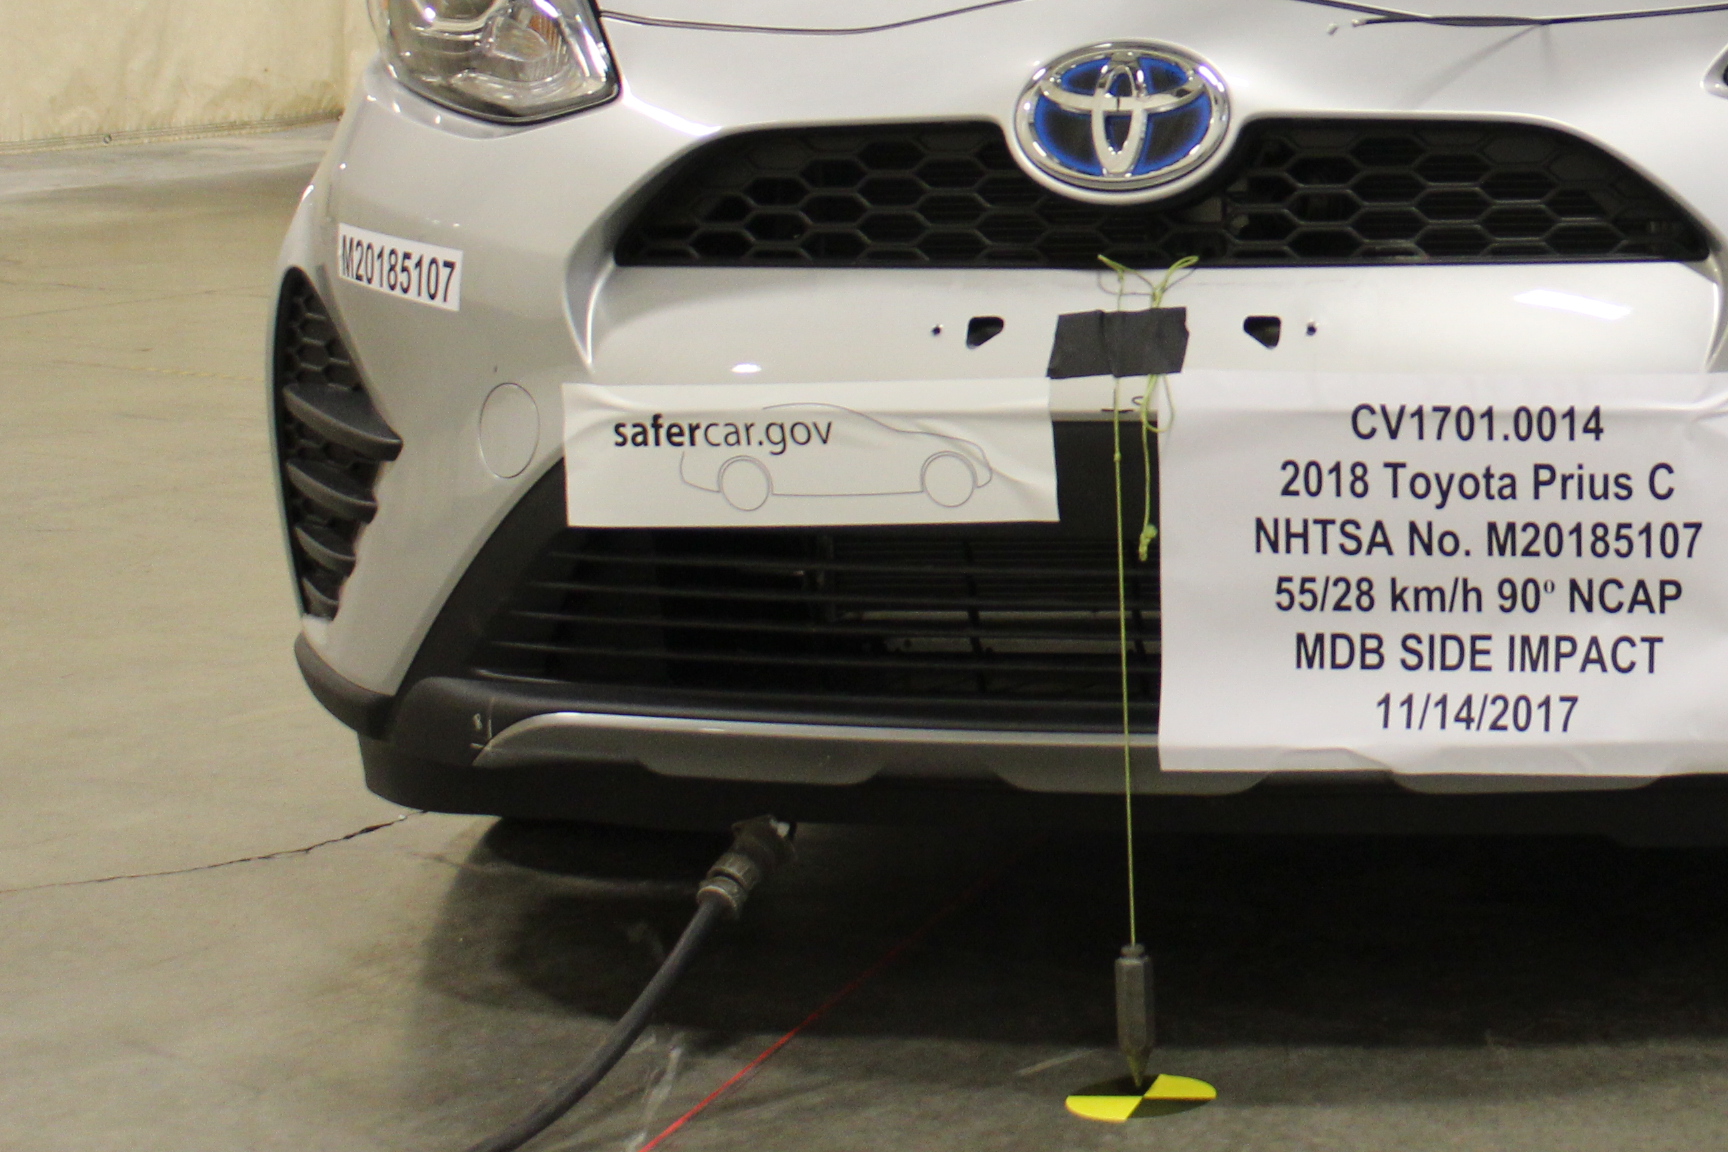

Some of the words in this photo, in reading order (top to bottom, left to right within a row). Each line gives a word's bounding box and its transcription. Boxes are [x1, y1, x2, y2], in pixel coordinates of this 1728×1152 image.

[342, 235, 457, 303] M20185107
[614, 414, 831, 455] safercar.gov
[1352, 404, 1603, 441] CV1701.0014
[1281, 460, 1368, 498] 2018
[1384, 462, 1516, 509] Toyota
[1534, 464, 1632, 500] Prius
[1649, 463, 1674, 500] C
[1256, 518, 1393, 555] NHTSA
[1409, 521, 1470, 556] No.
[1488, 522, 1702, 558] M20185107
[1277, 577, 1374, 612] 55/28
[1391, 578, 1482, 612] km/h
[1570, 579, 1682, 614] NCAP
[1297, 633, 1384, 669] MDB
[1401, 634, 1492, 671] SIDE
[1509, 635, 1663, 673] IMPACT
[1378, 694, 1578, 732] 11/14/2017
